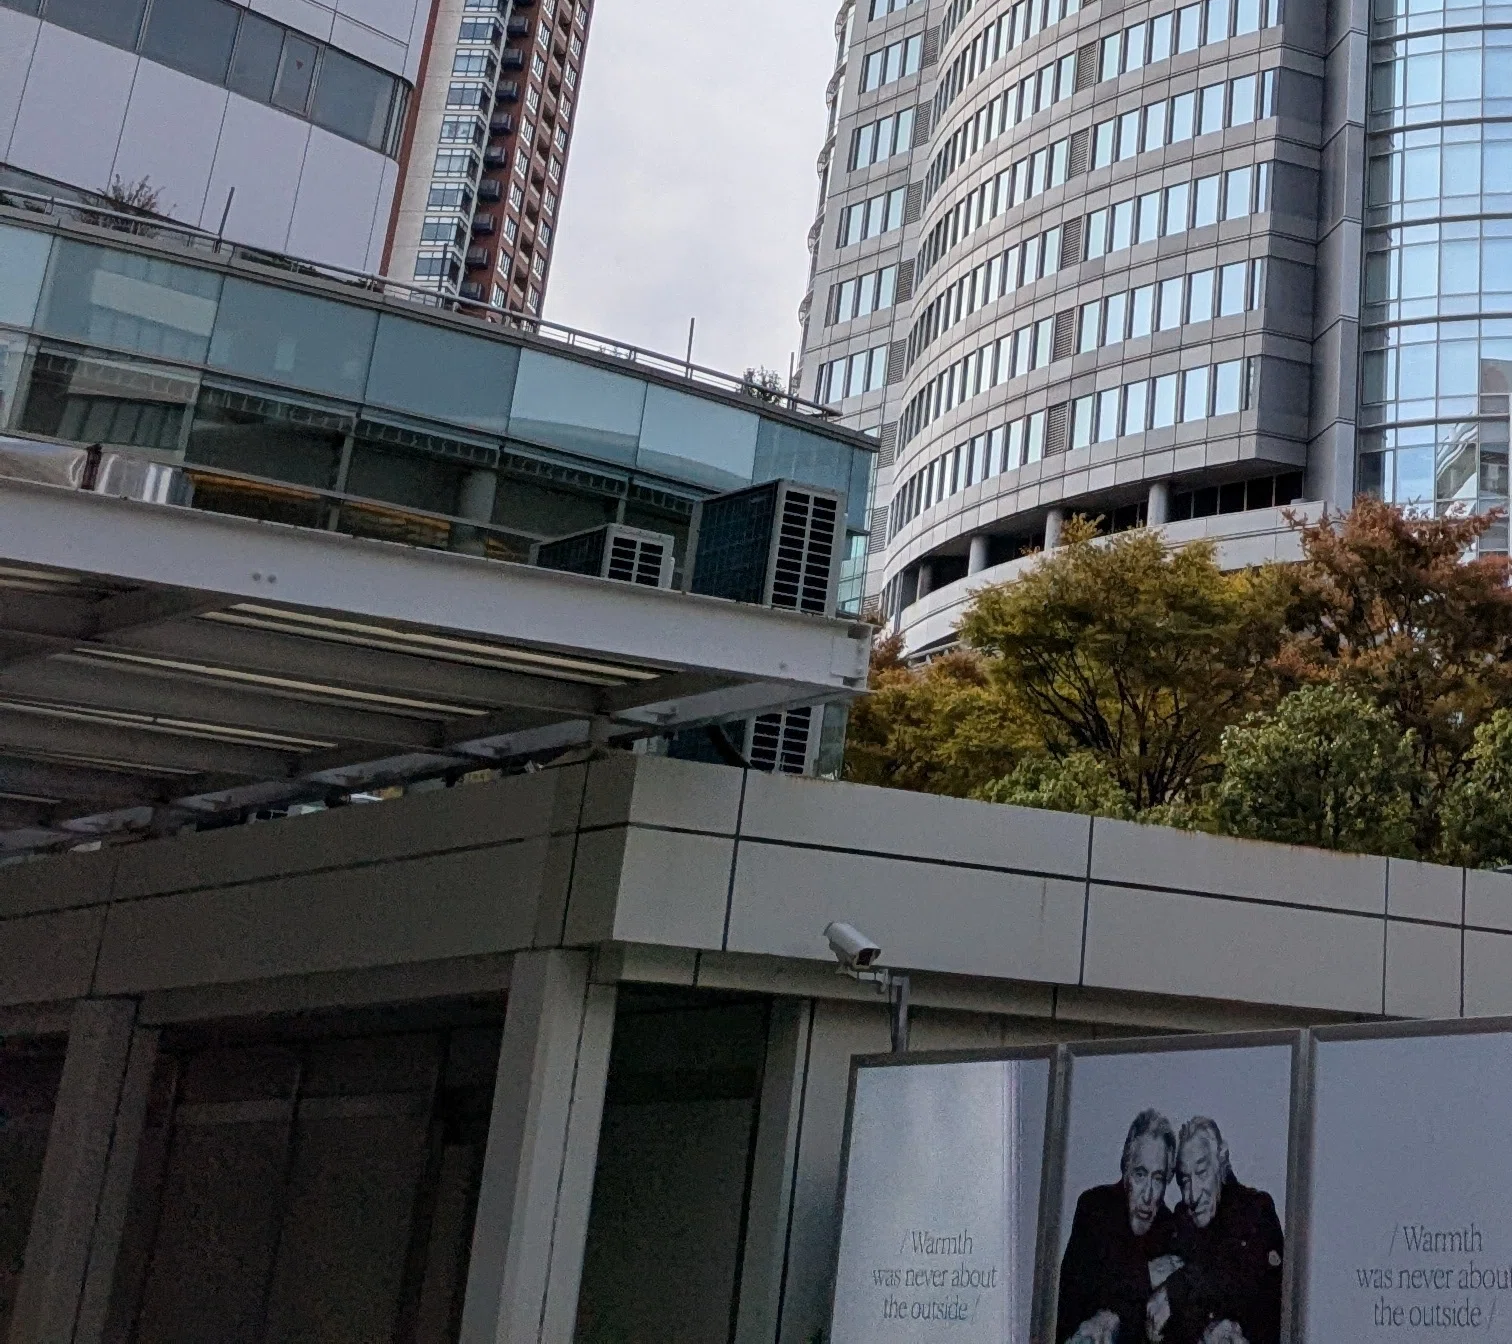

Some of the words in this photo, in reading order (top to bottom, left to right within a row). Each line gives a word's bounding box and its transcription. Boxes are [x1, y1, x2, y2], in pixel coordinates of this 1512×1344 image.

[912, 1228, 973, 1254] Warmth
[1403, 1222, 1482, 1253] Warmth
[872, 1268, 901, 1287] was
[905, 1268, 948, 1288] never
[951, 1262, 998, 1288] about
[1356, 1268, 1393, 1290] was
[1398, 1268, 1453, 1290] never
[883, 1294, 907, 1319] the
[911, 1295, 968, 1321] outside
[1374, 1296, 1404, 1327] the
[1409, 1298, 1482, 1328] outside
